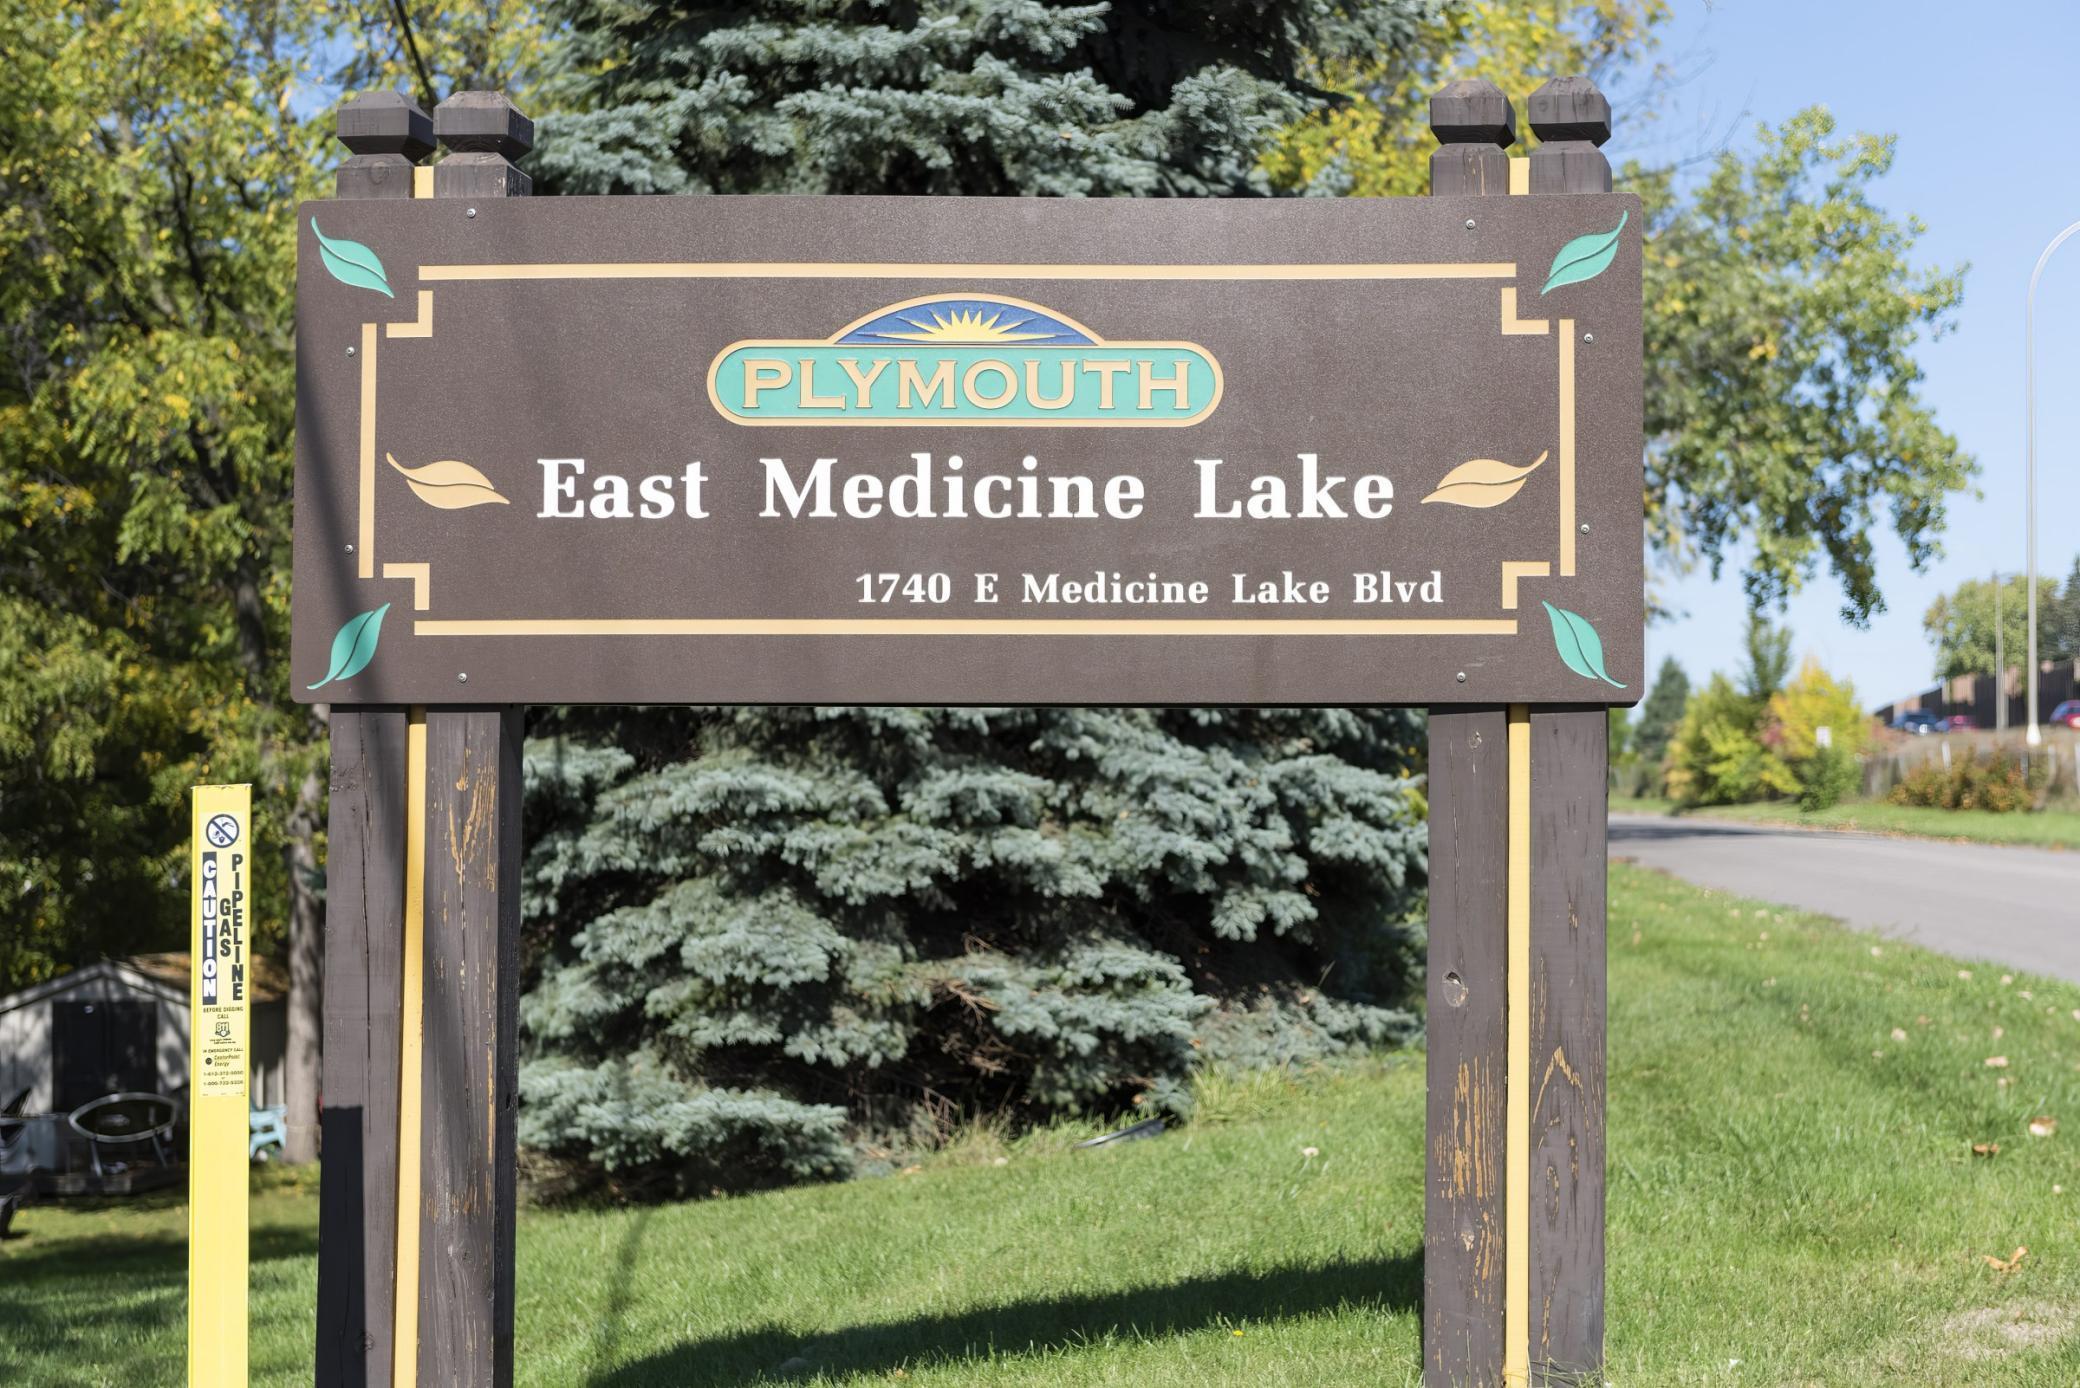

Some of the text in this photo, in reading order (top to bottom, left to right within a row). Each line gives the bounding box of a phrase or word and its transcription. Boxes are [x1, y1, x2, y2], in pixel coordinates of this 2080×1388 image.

[741, 357, 1192, 411] PLYMOUTH
[537, 452, 1394, 520] East Medicine Lake
[855, 570, 1444, 605] 1740 E Medicine Lake Blvd
[203, 859, 217, 998] CAUTION
[219, 898, 232, 957] GAS
[231, 853, 244, 1001] PIPELINE
